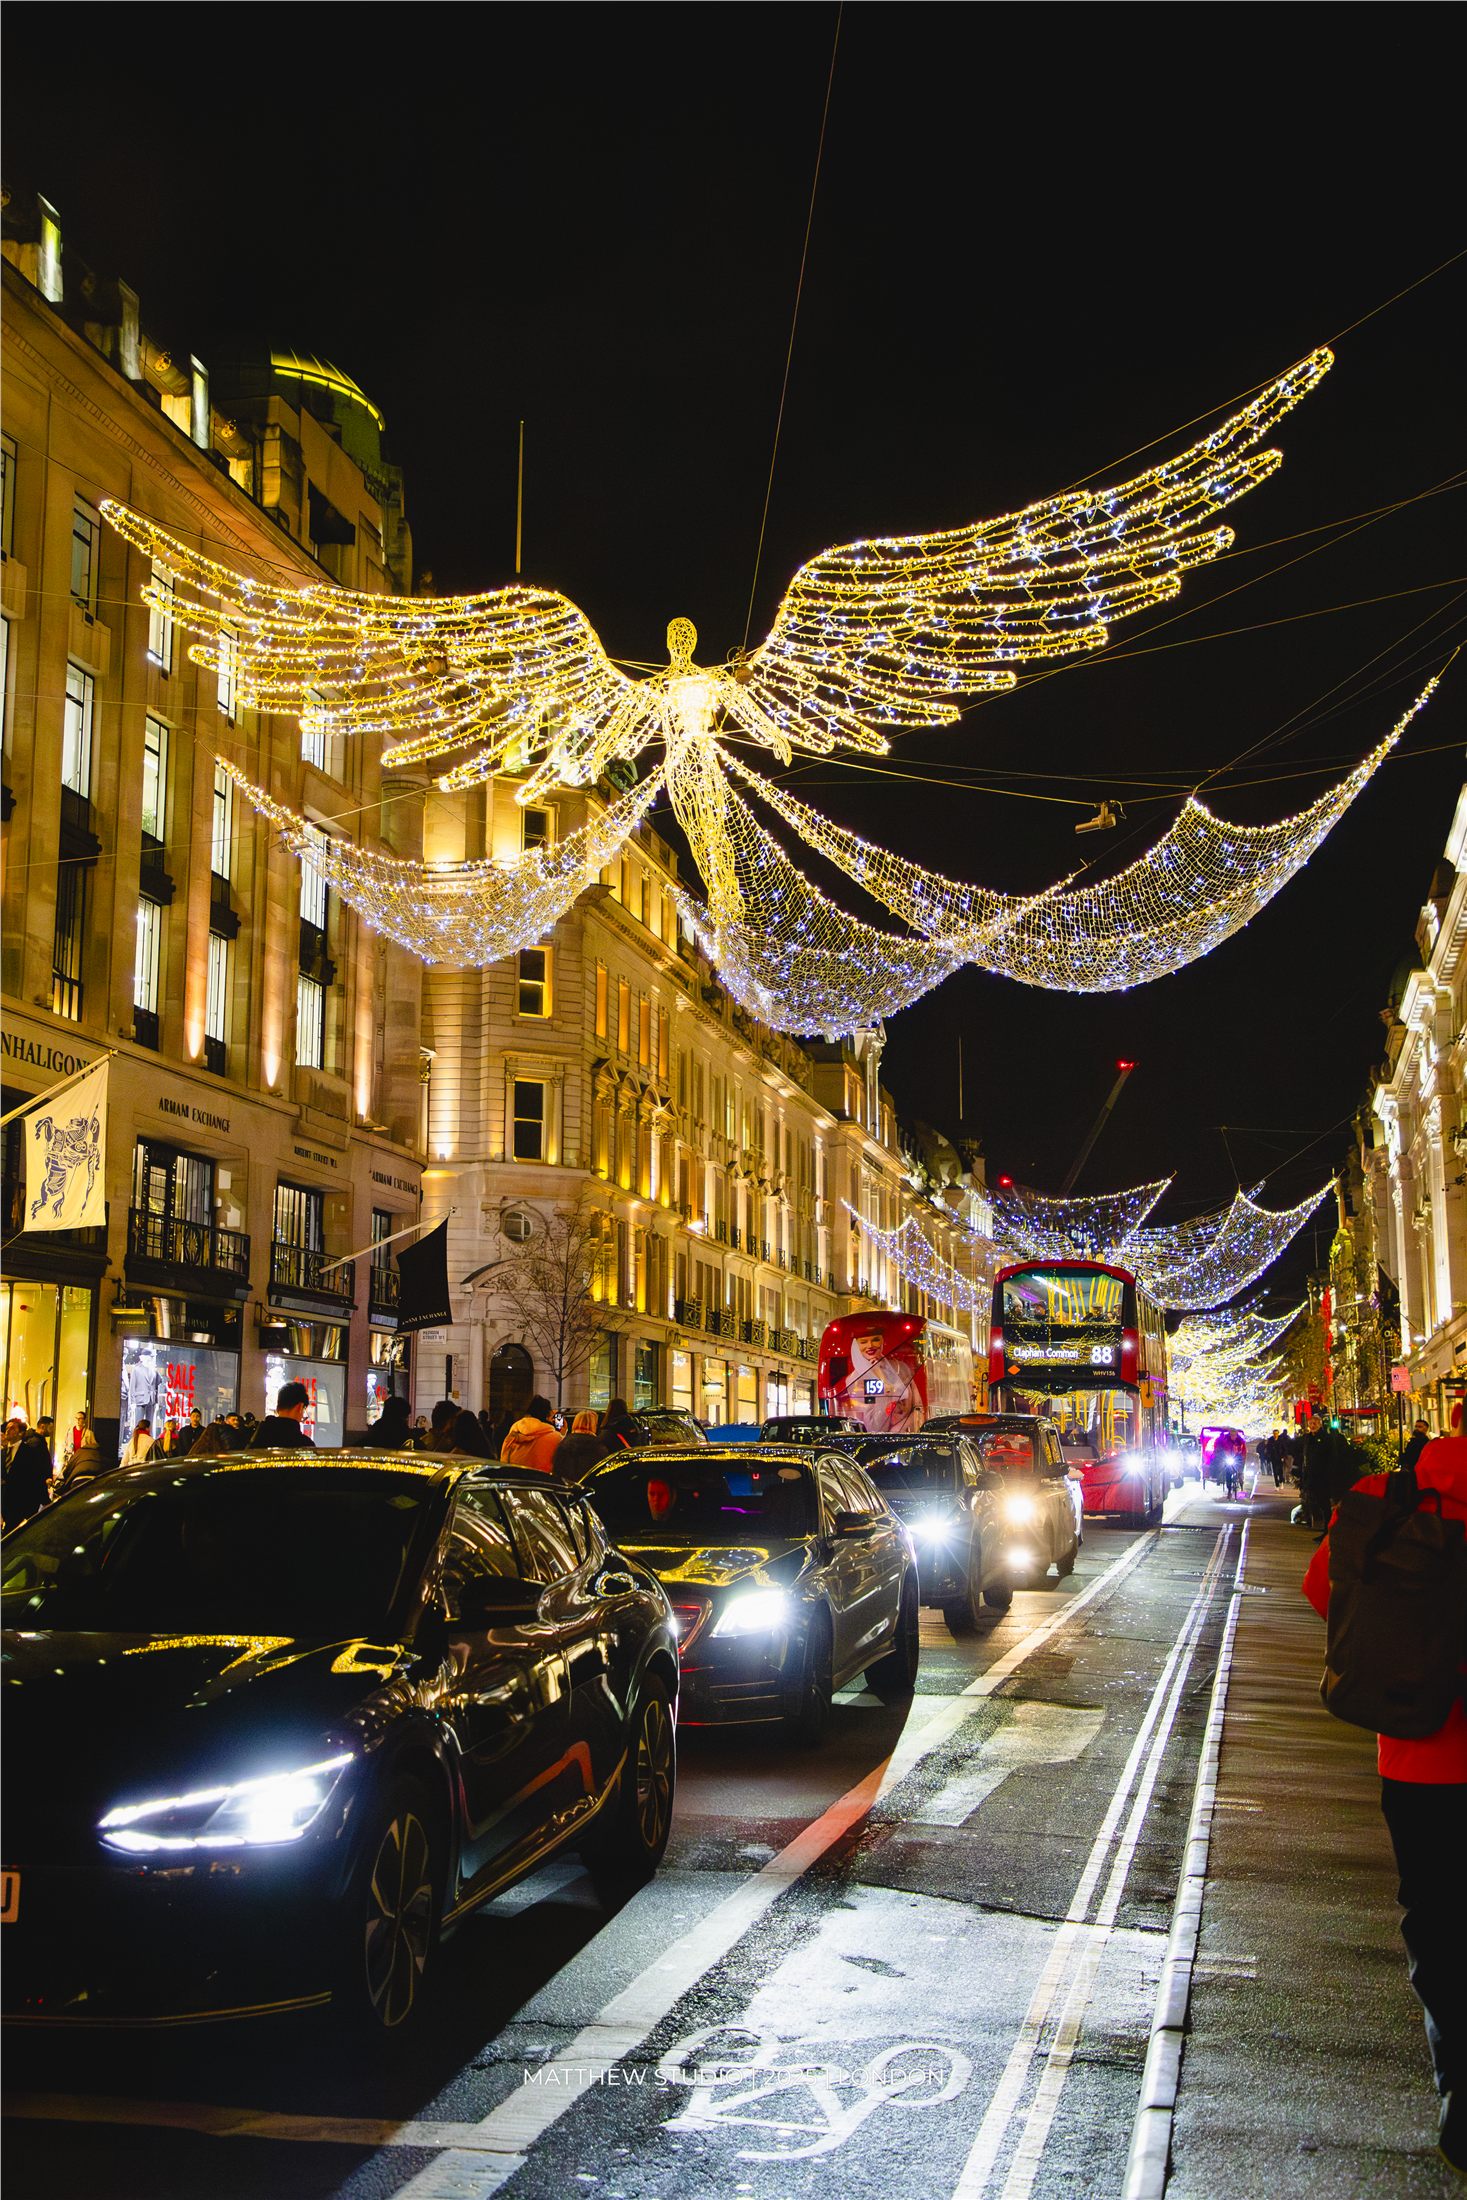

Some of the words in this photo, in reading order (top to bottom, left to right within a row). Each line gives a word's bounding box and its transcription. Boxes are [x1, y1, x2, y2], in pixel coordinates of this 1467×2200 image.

[159, 1096, 189, 1118] ARMANI
[192, 1107, 230, 1133] EXCHANGE
[1013, 1347, 1044, 1359] Clapham
[1046, 1347, 1079, 1358] Common
[1091, 1345, 1113, 1364] 88
[167, 1363, 197, 1391] SALE
[866, 1380, 884, 1394] 159
[165, 1391, 195, 1417] SALE
